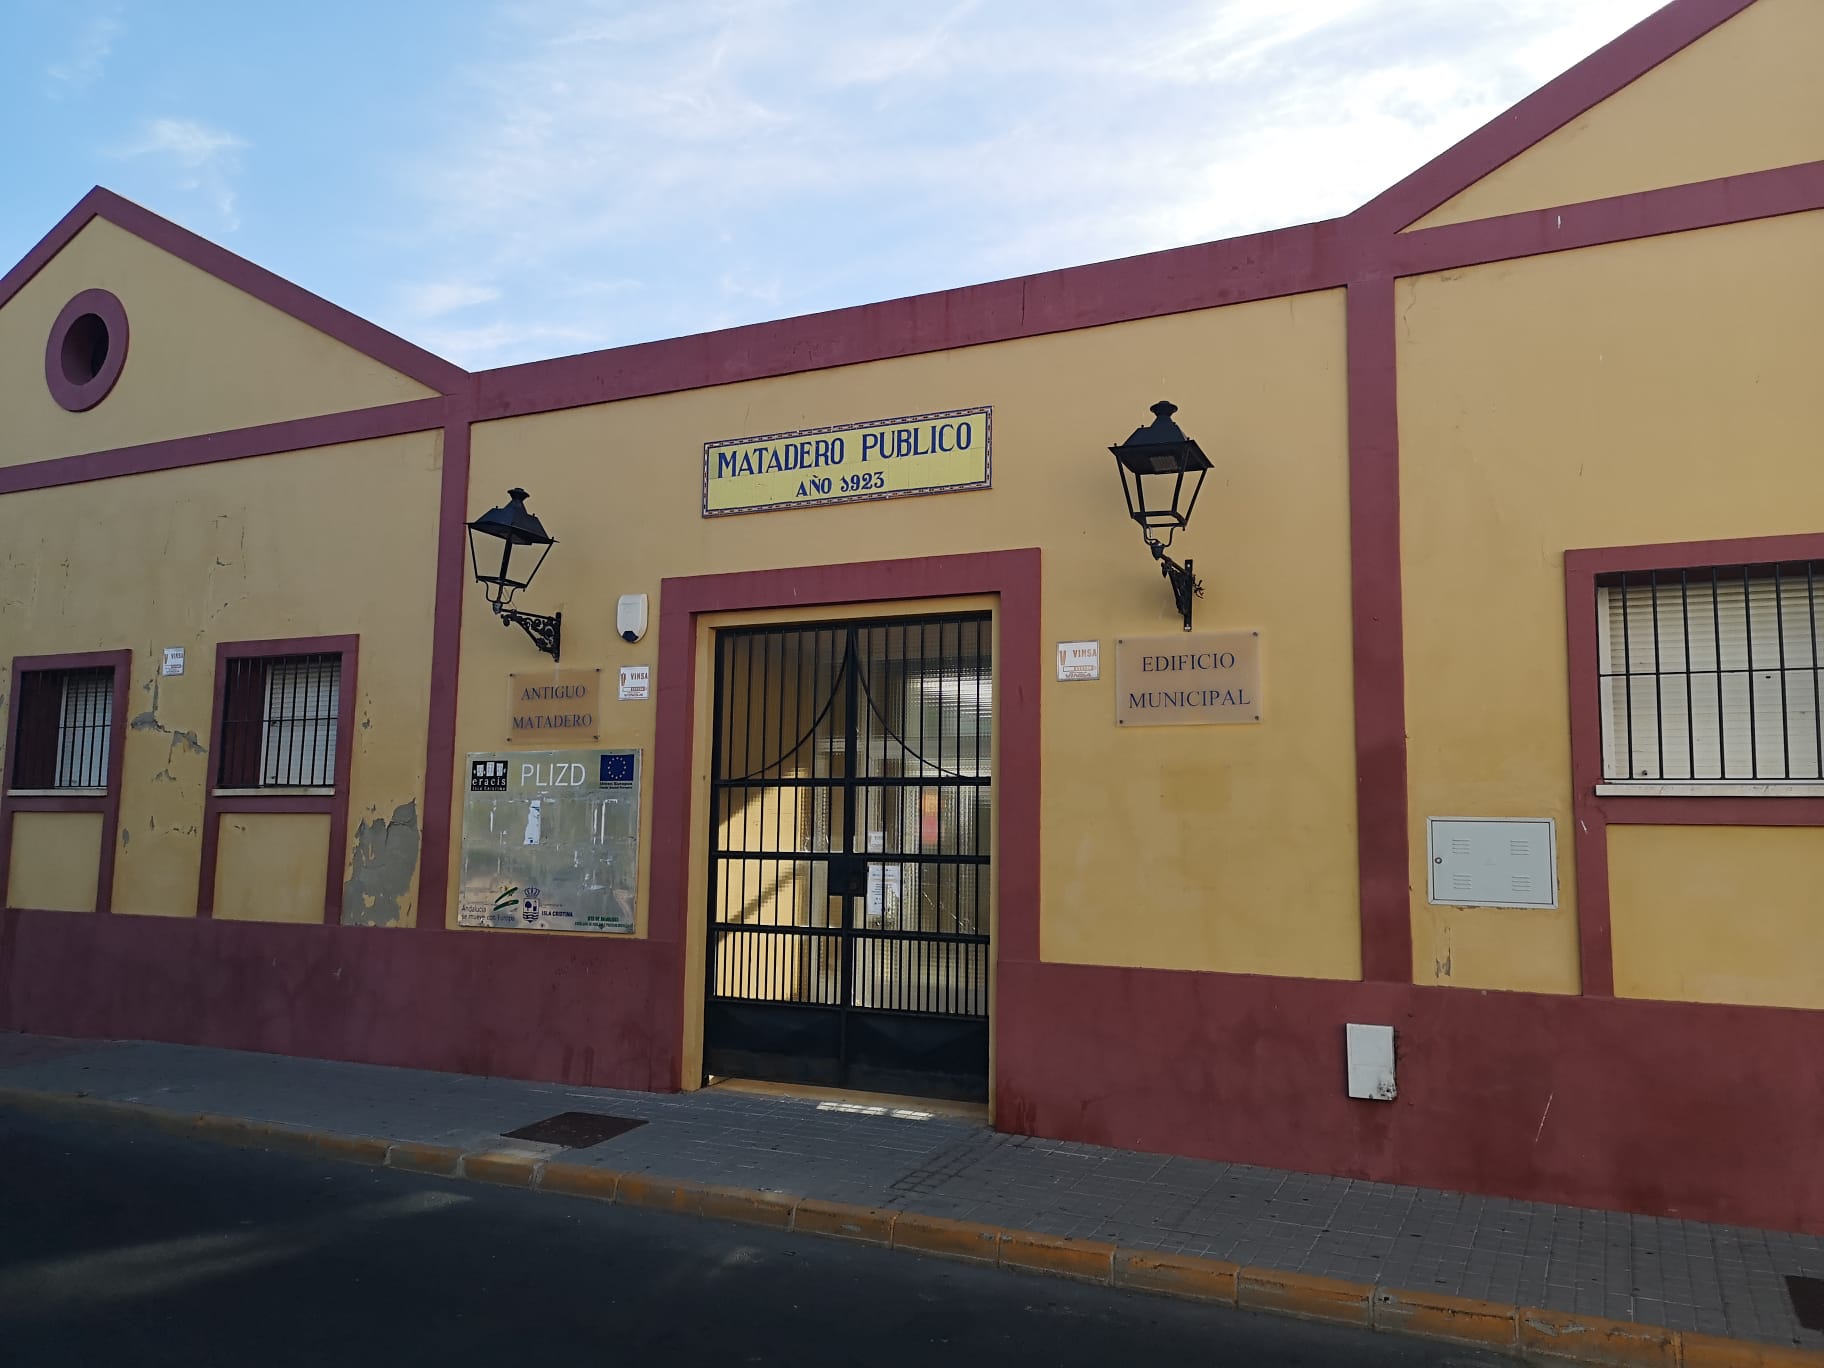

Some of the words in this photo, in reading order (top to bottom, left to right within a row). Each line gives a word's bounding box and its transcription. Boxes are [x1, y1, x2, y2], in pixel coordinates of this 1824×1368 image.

[717, 437, 845, 478] MATADERO
[862, 421, 972, 461] PUBLICO
[796, 474, 832, 497] AÑO
[1073, 648, 1097, 658] VINSA
[1142, 652, 1235, 672] EDIFICIO
[630, 672, 649, 681] VINSA
[520, 685, 586, 701] ANTIGUO
[1129, 689, 1250, 709] MUNICIPAL
[512, 713, 592, 730] MATADERO
[472, 776, 506, 786] eracis
[520, 763, 586, 787] PLIZD
